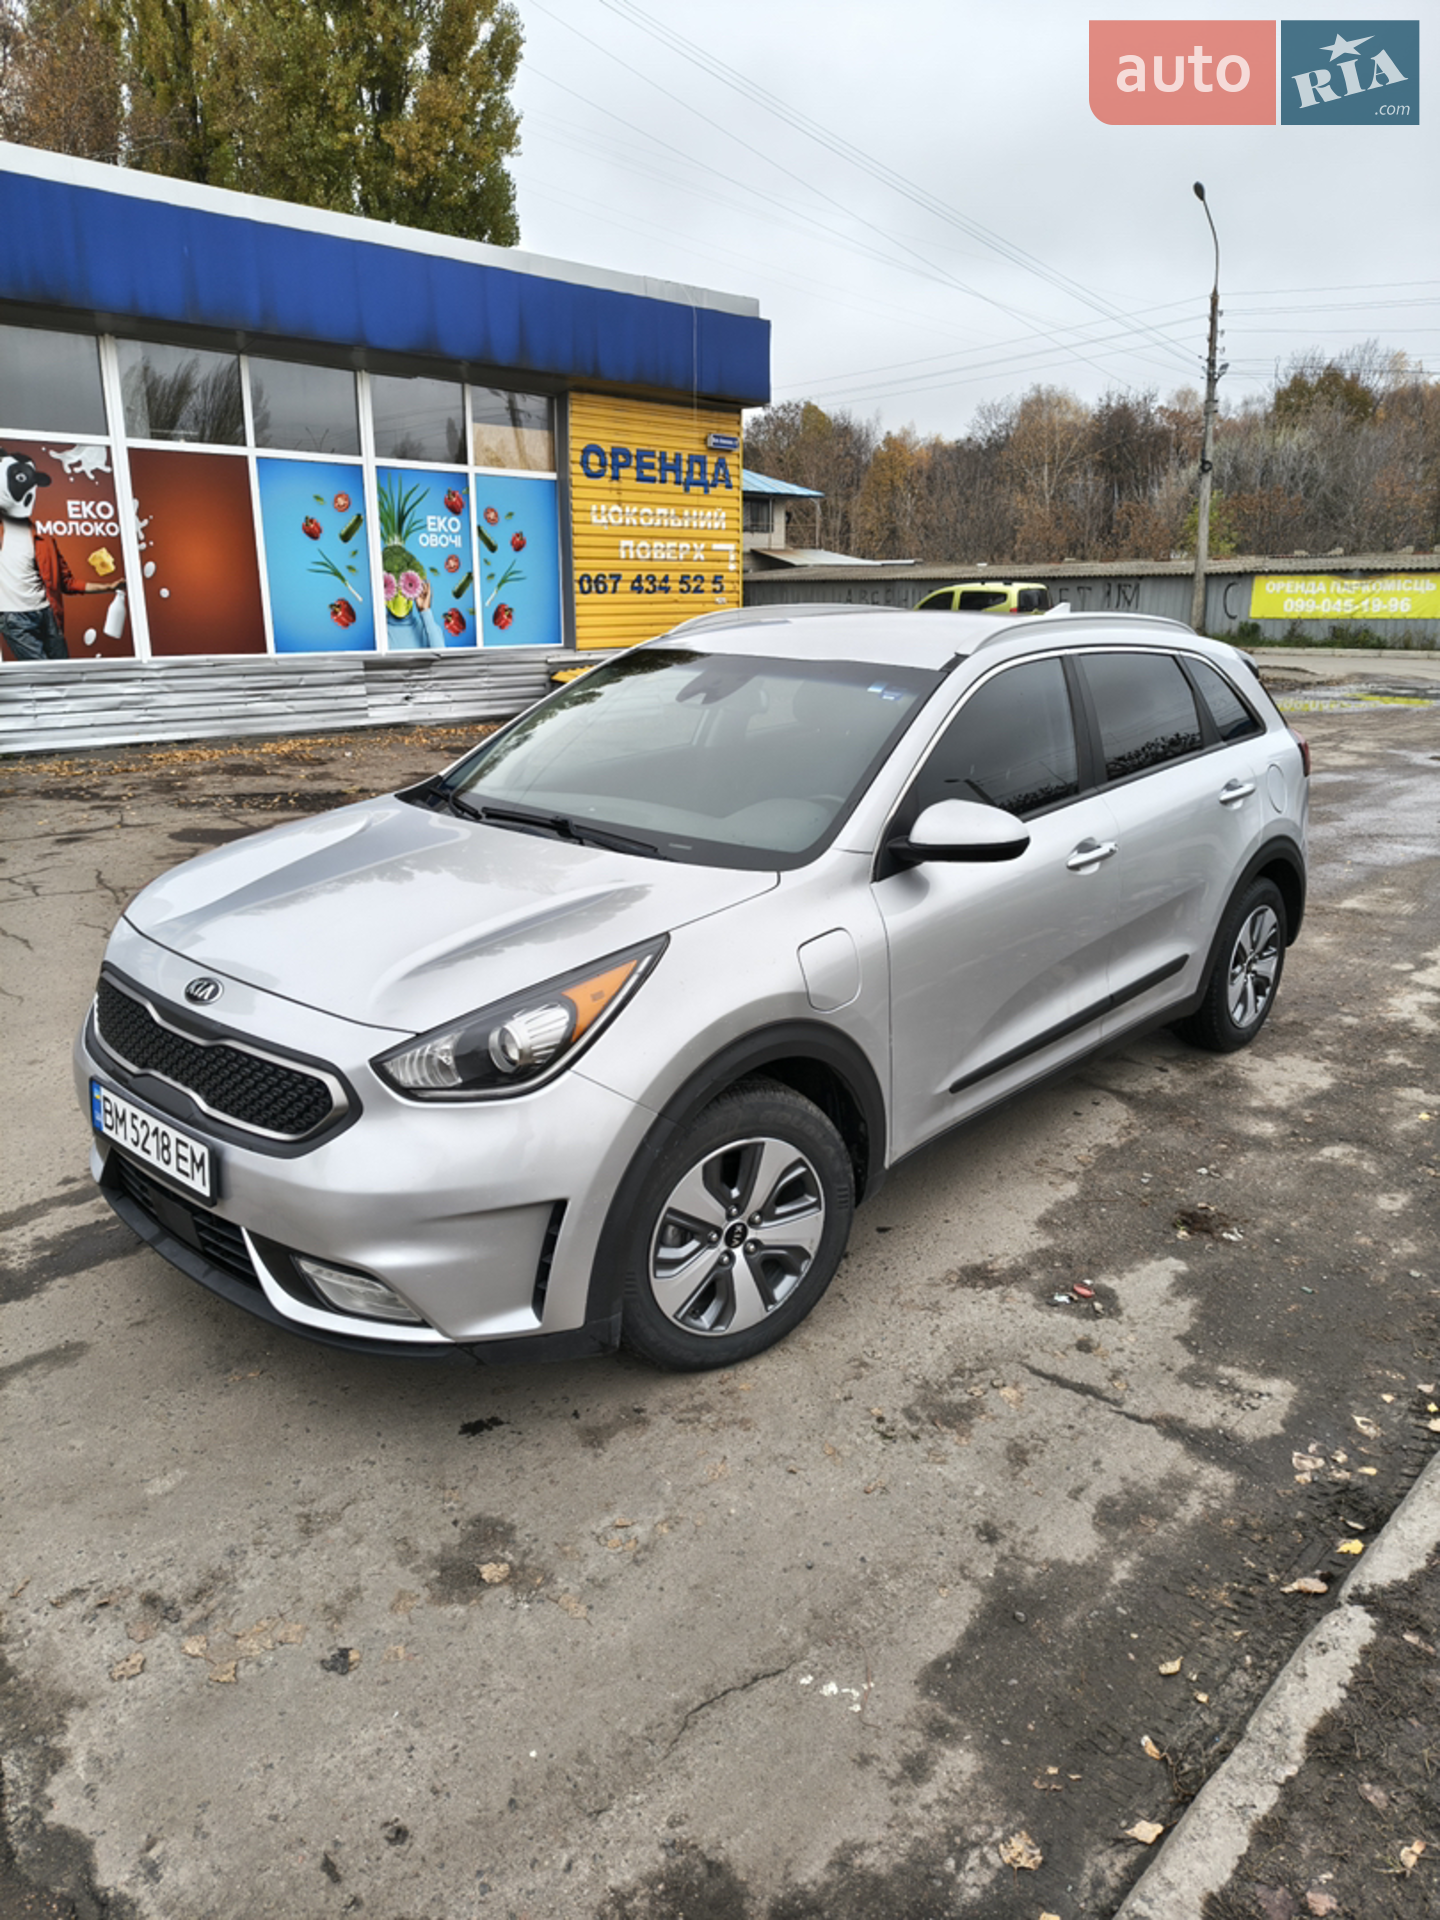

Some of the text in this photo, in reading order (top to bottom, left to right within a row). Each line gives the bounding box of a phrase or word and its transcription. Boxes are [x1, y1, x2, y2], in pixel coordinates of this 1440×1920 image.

[580, 444, 734, 494] ОРЕНДА
[67, 501, 114, 519] ЕКО
[590, 504, 727, 530] ЦОКОЛЬНИЙ
[35, 520, 121, 537] МОЛОКО
[426, 516, 462, 532] ЕКО
[418, 534, 462, 548] ОВОЧІ
[619, 539, 706, 562] ПОВЕРХ
[578, 573, 725, 594] 067 434 52 5
[1265, 578, 1438, 594] ОРЕНДА ПАРКОМІСЦЬ
[187, 980, 216, 1000] KIA
[102, 1095, 206, 1188] BM 5218 EM
